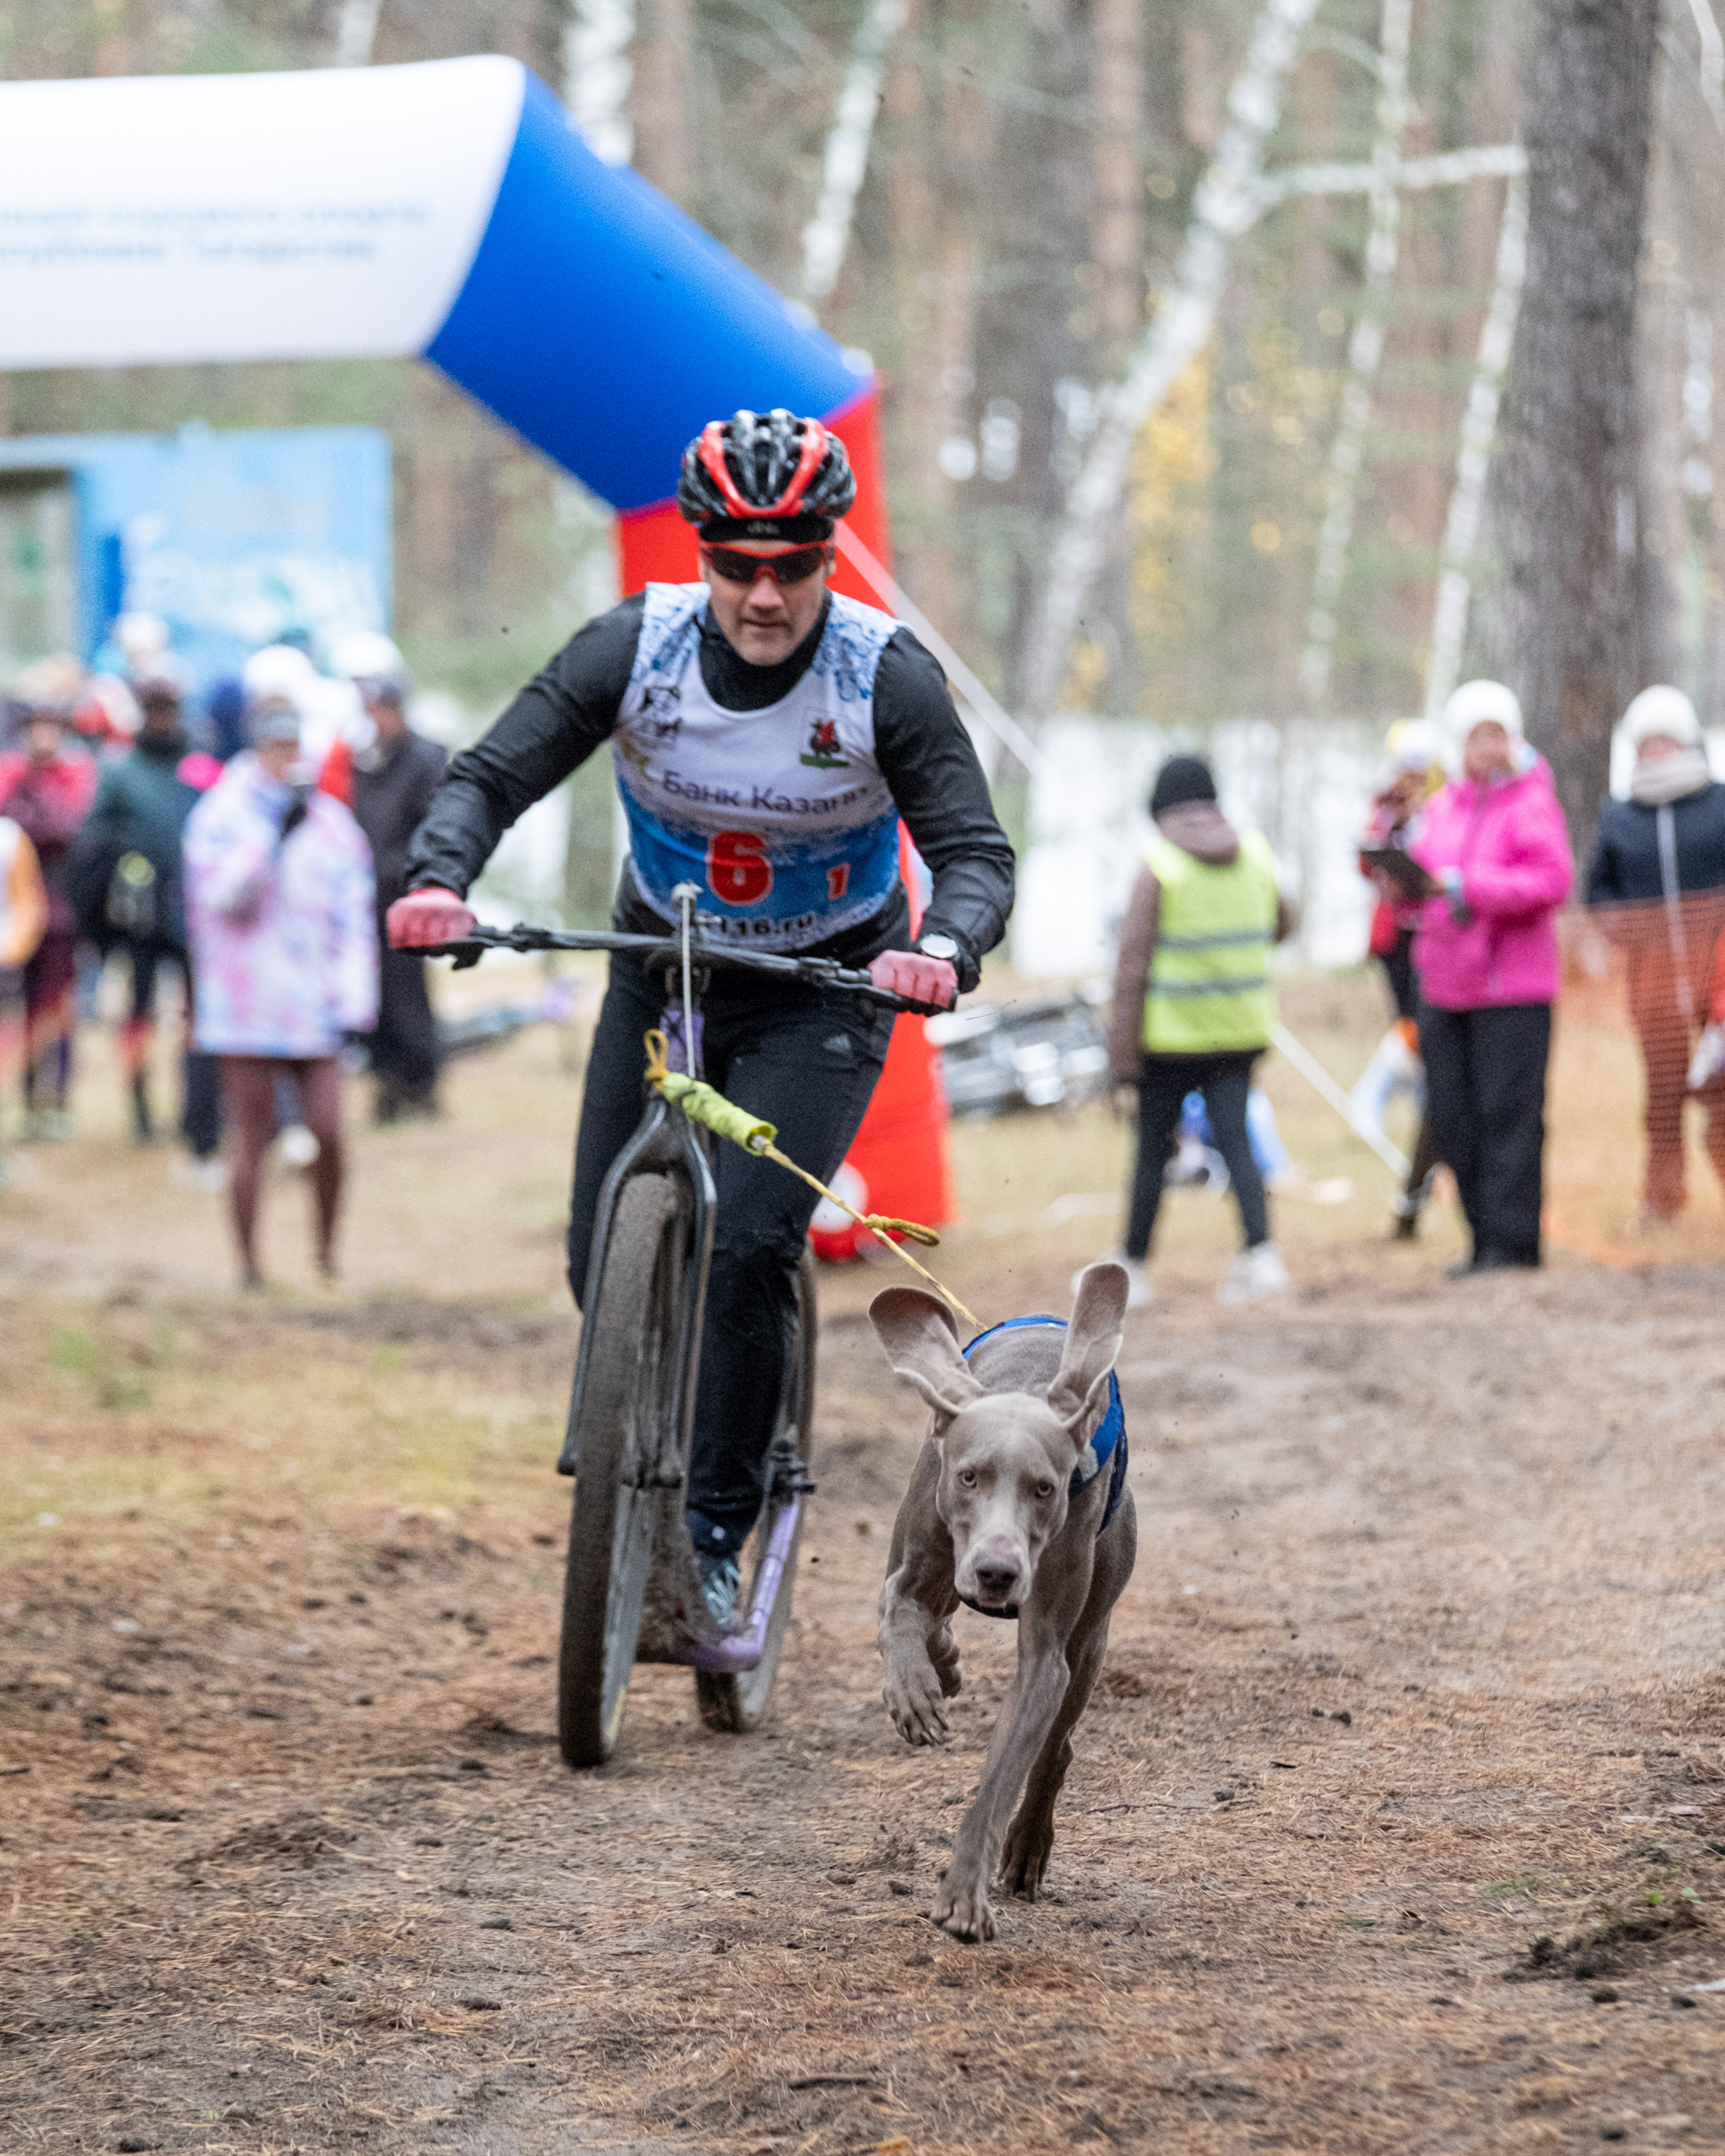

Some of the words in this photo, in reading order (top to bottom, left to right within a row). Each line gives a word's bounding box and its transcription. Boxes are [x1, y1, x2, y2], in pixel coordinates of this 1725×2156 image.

[662, 770, 739, 808] Банк
[707, 830, 773, 906] 6
[827, 862, 850, 900] 1
